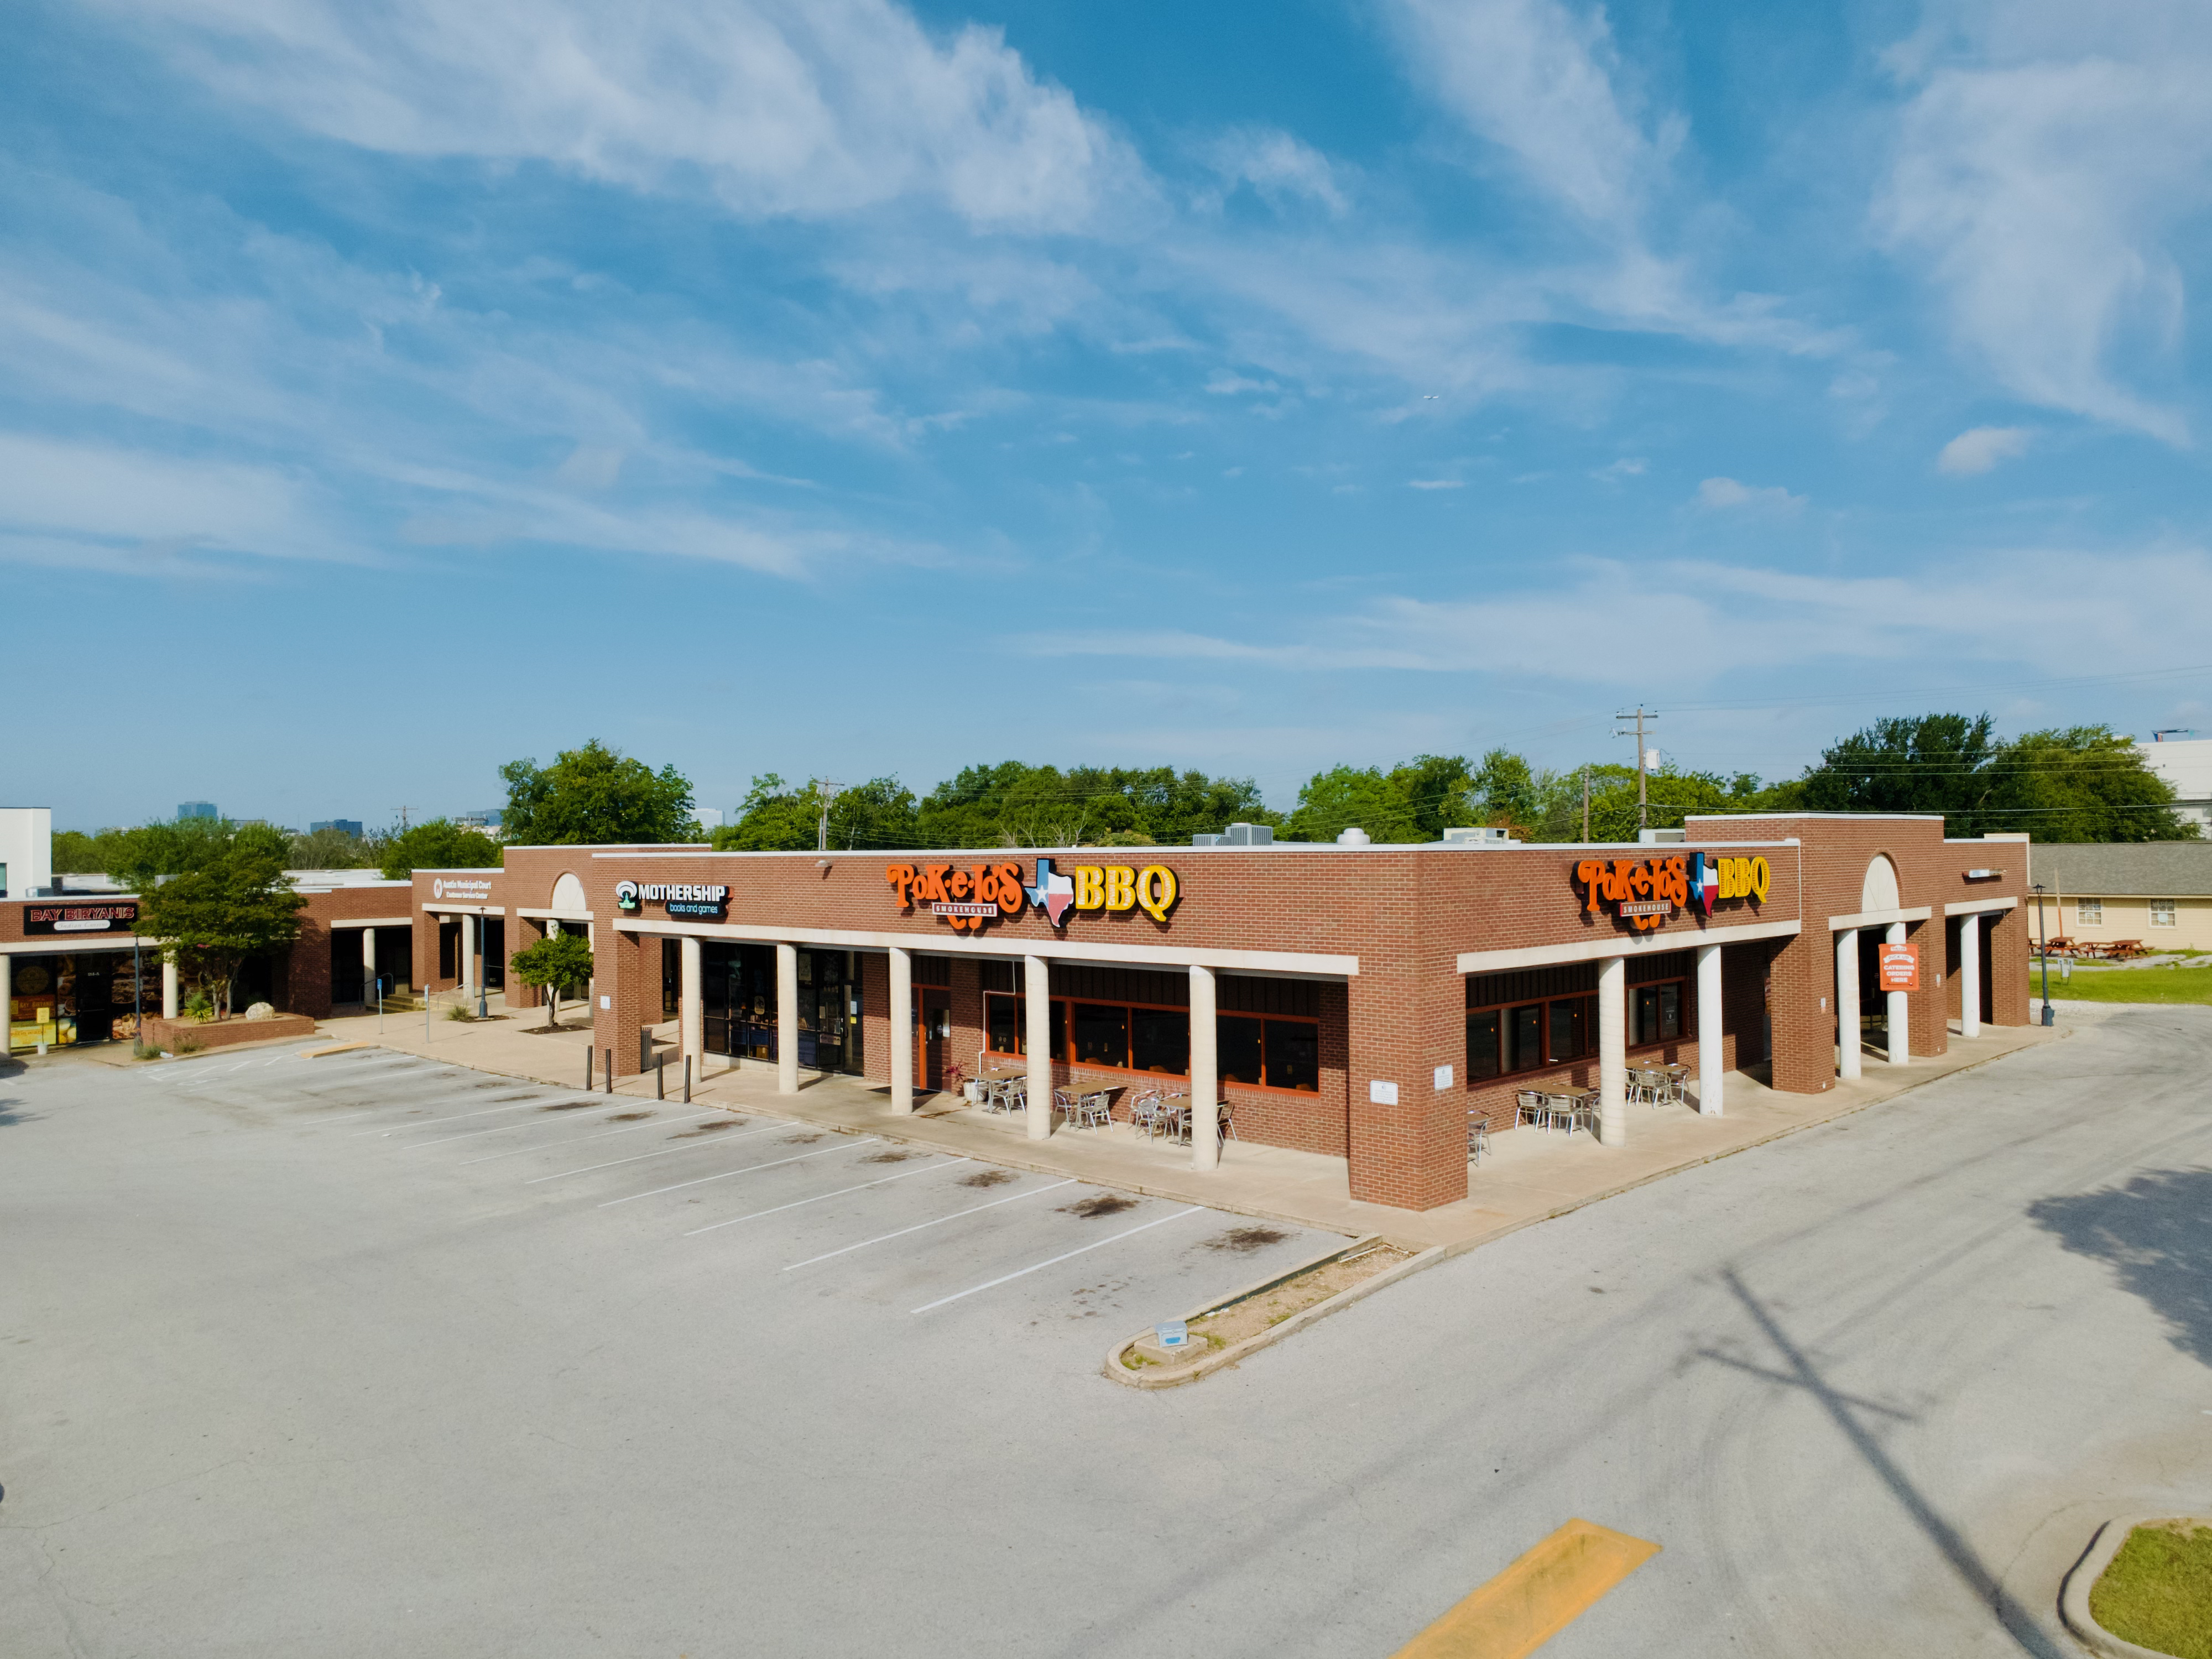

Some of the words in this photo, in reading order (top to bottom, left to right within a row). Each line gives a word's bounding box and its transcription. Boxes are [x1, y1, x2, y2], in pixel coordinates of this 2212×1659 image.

[1718, 856, 1770, 903] BBQ
[638, 885, 726, 901] MOTHERSHIP
[1075, 865, 1176, 922] BBQ
[30, 909, 62, 922] BAY
[64, 907, 134, 921] BIRYANIS
[670, 903, 686, 912] books
[686, 904, 698, 912] and
[698, 905, 718, 915] games
[936, 905, 993, 914] SMOKEHOUSE
[1623, 903, 1669, 914] SMOKEHOUSE
